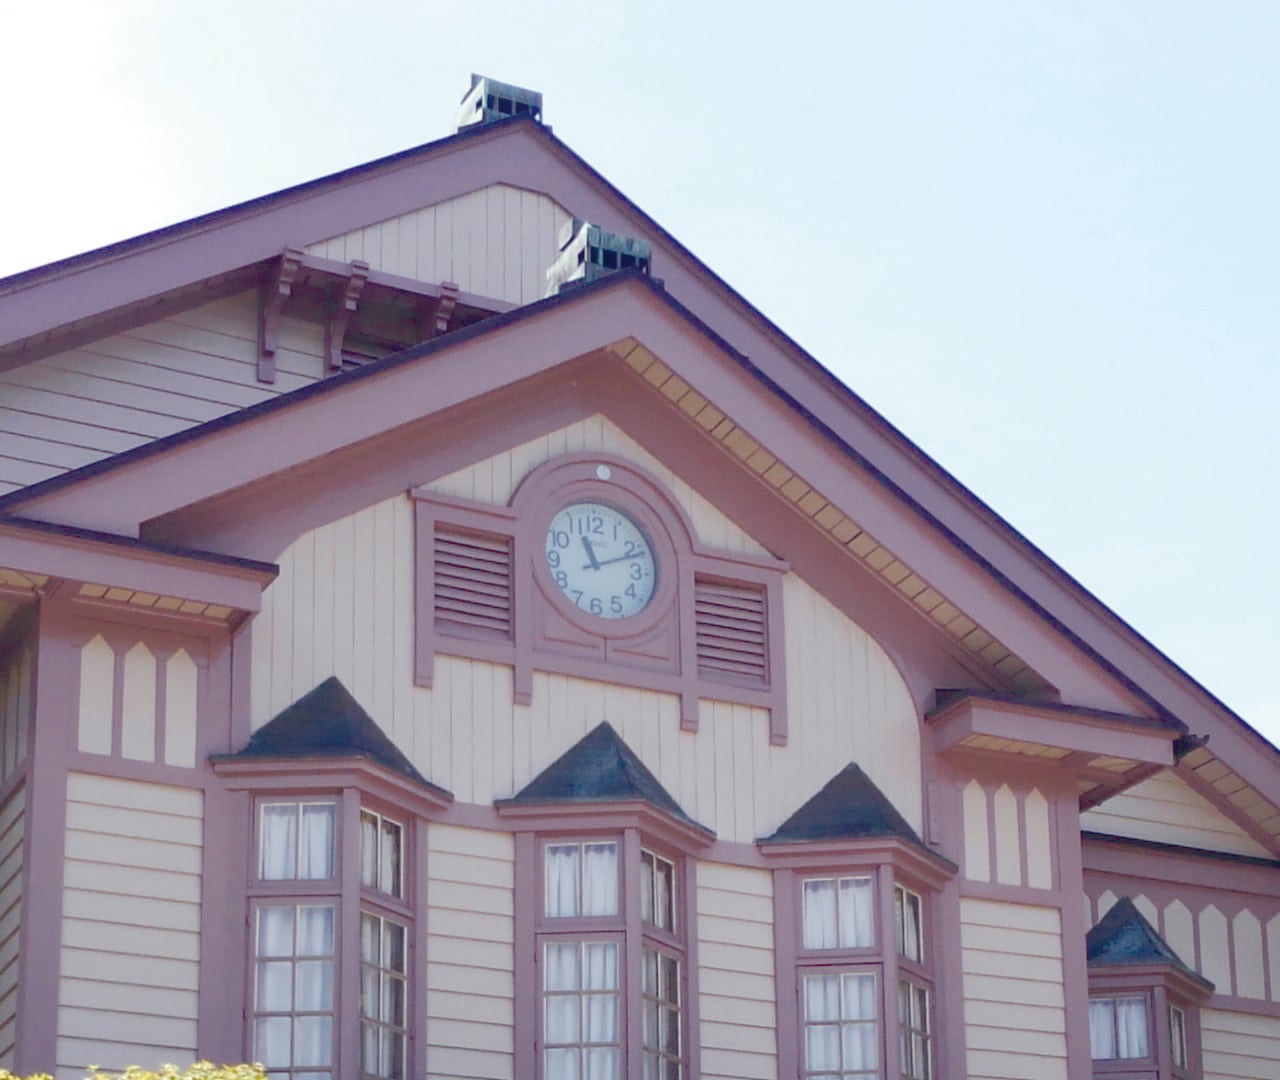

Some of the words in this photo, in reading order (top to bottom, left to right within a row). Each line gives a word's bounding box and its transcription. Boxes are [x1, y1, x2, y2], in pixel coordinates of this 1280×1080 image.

[569, 517, 582, 535] 11
[586, 515, 604, 534] 12
[552, 530, 570, 548] 10
[624, 541, 635, 556] 2
[548, 550, 560, 568] 9
[556, 571, 568, 589] 8
[630, 563, 642, 580] 3
[571, 590, 583, 605] 7
[624, 583, 637, 600] 4
[590, 598, 602, 615] 6
[610, 596, 622, 613] 5
